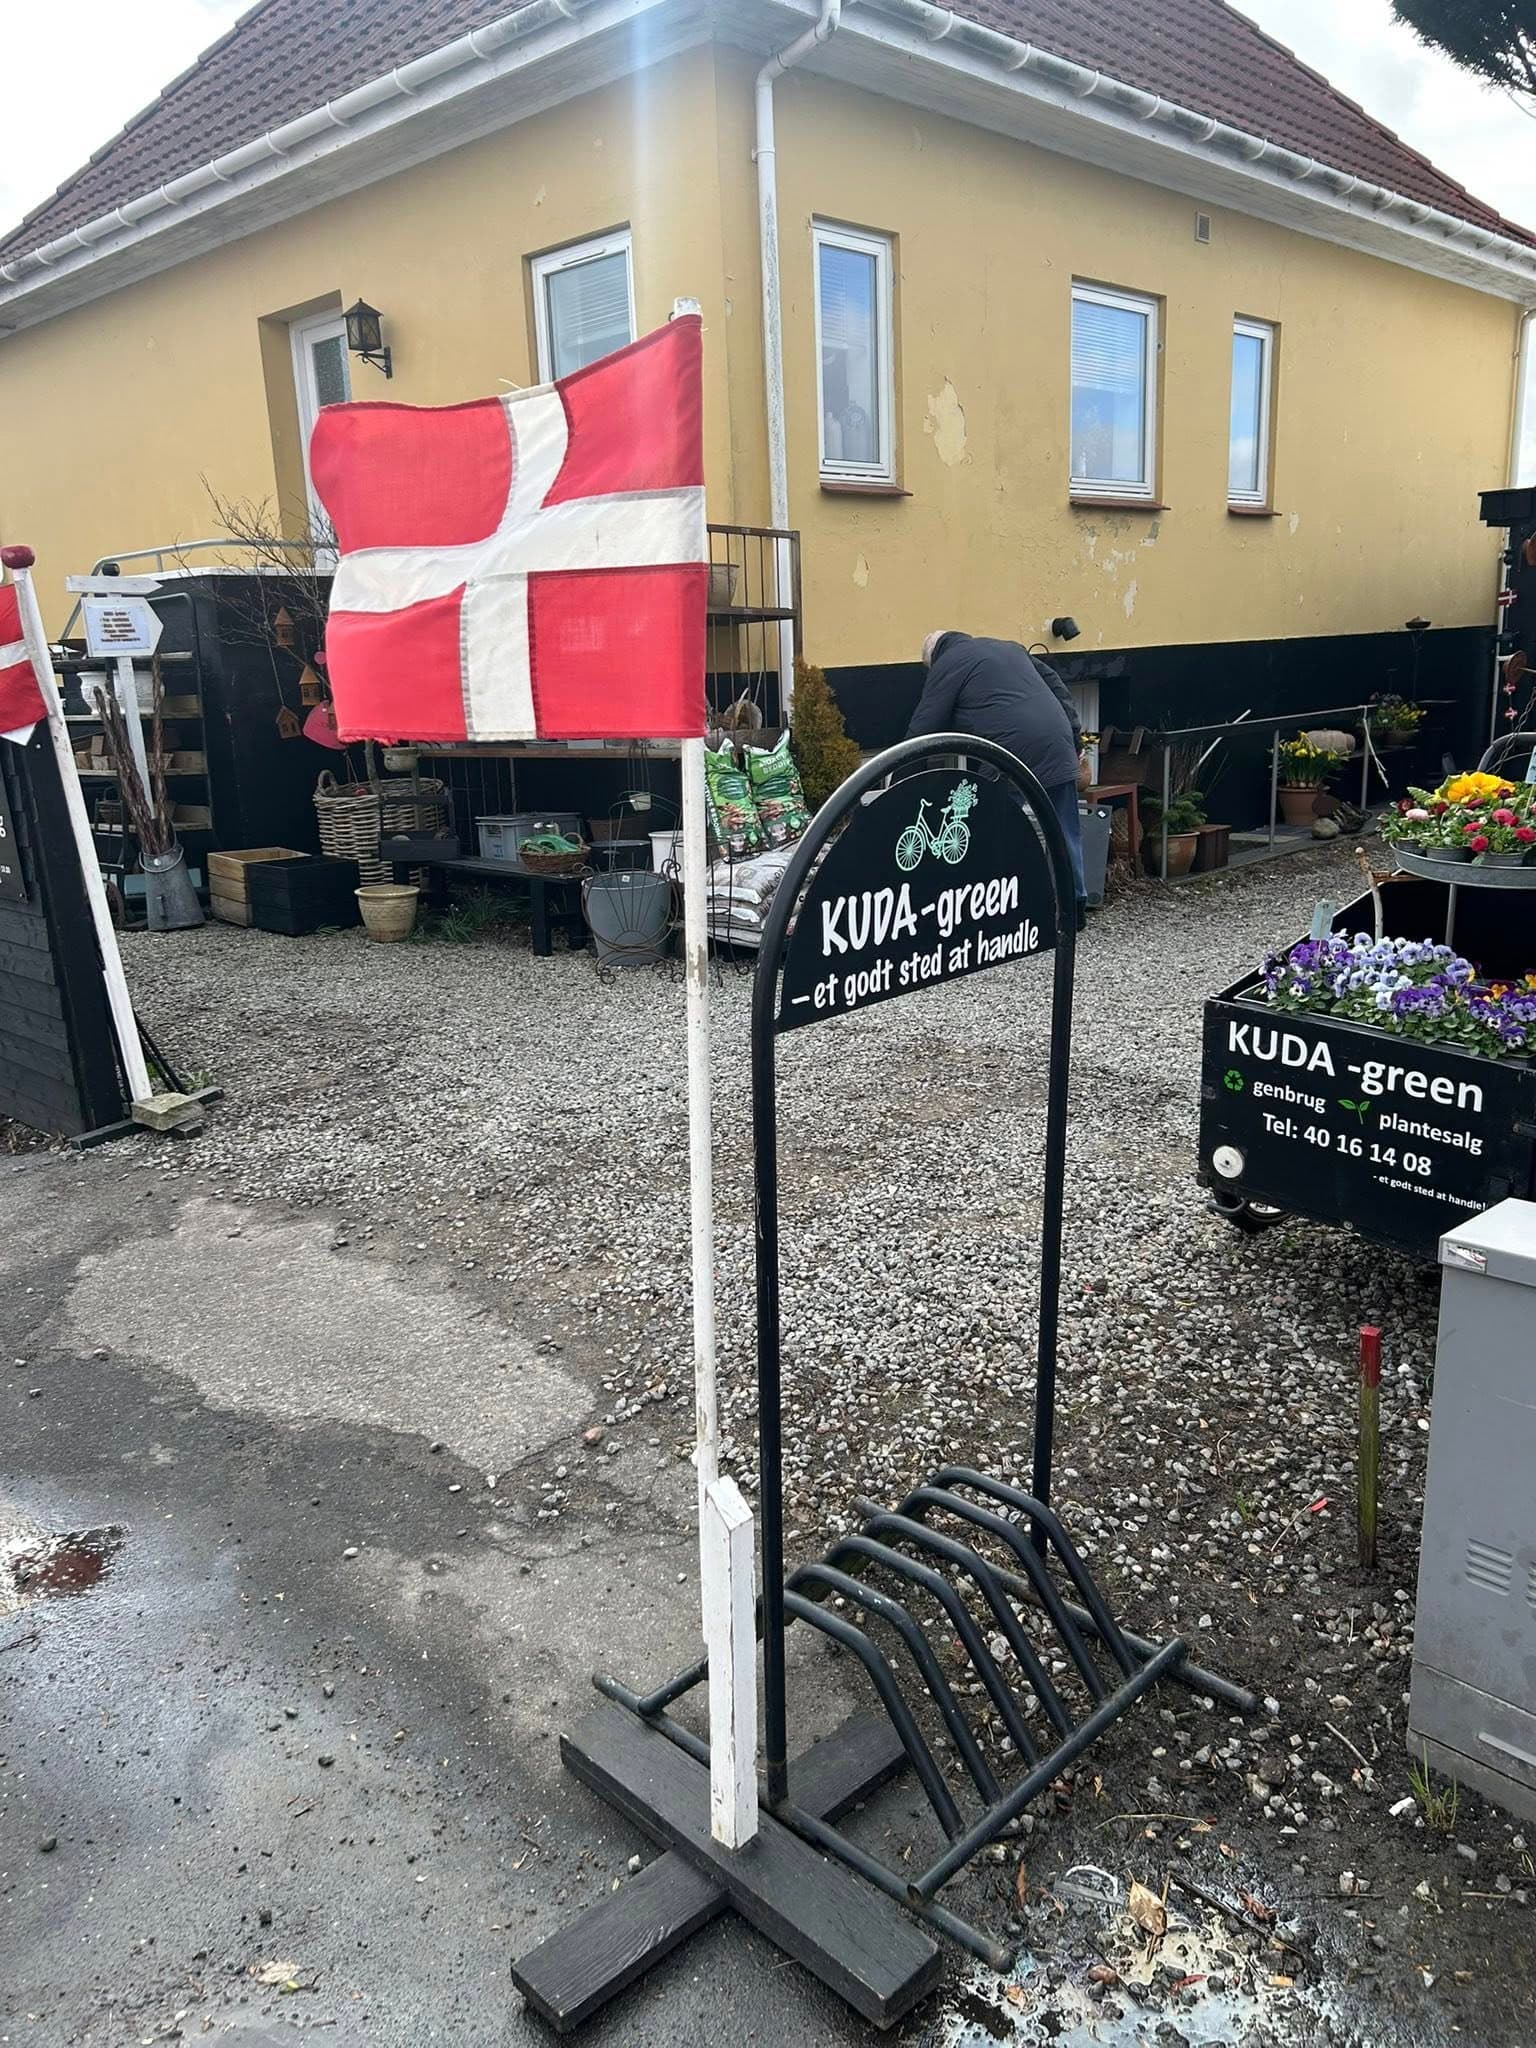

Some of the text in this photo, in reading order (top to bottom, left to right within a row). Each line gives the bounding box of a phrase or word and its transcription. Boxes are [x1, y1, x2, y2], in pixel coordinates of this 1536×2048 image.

[822, 875, 1018, 956] KUDA-green
[844, 959, 894, 1006] godt
[899, 945, 942, 985] sted
[949, 939, 972, 971] at
[977, 919, 1039, 964] handle
[1228, 1020, 1336, 1077] KUDA
[1253, 1081, 1483, 1155] genbrug plantesalg
[1262, 1112, 1432, 1176] Tel: 40 16 14 08
[1390, 1178, 1412, 1191] godt
[1413, 1185, 1434, 1197] sted
[1436, 1192, 1447, 1201] at
[1448, 1193, 1486, 1211] handle!
